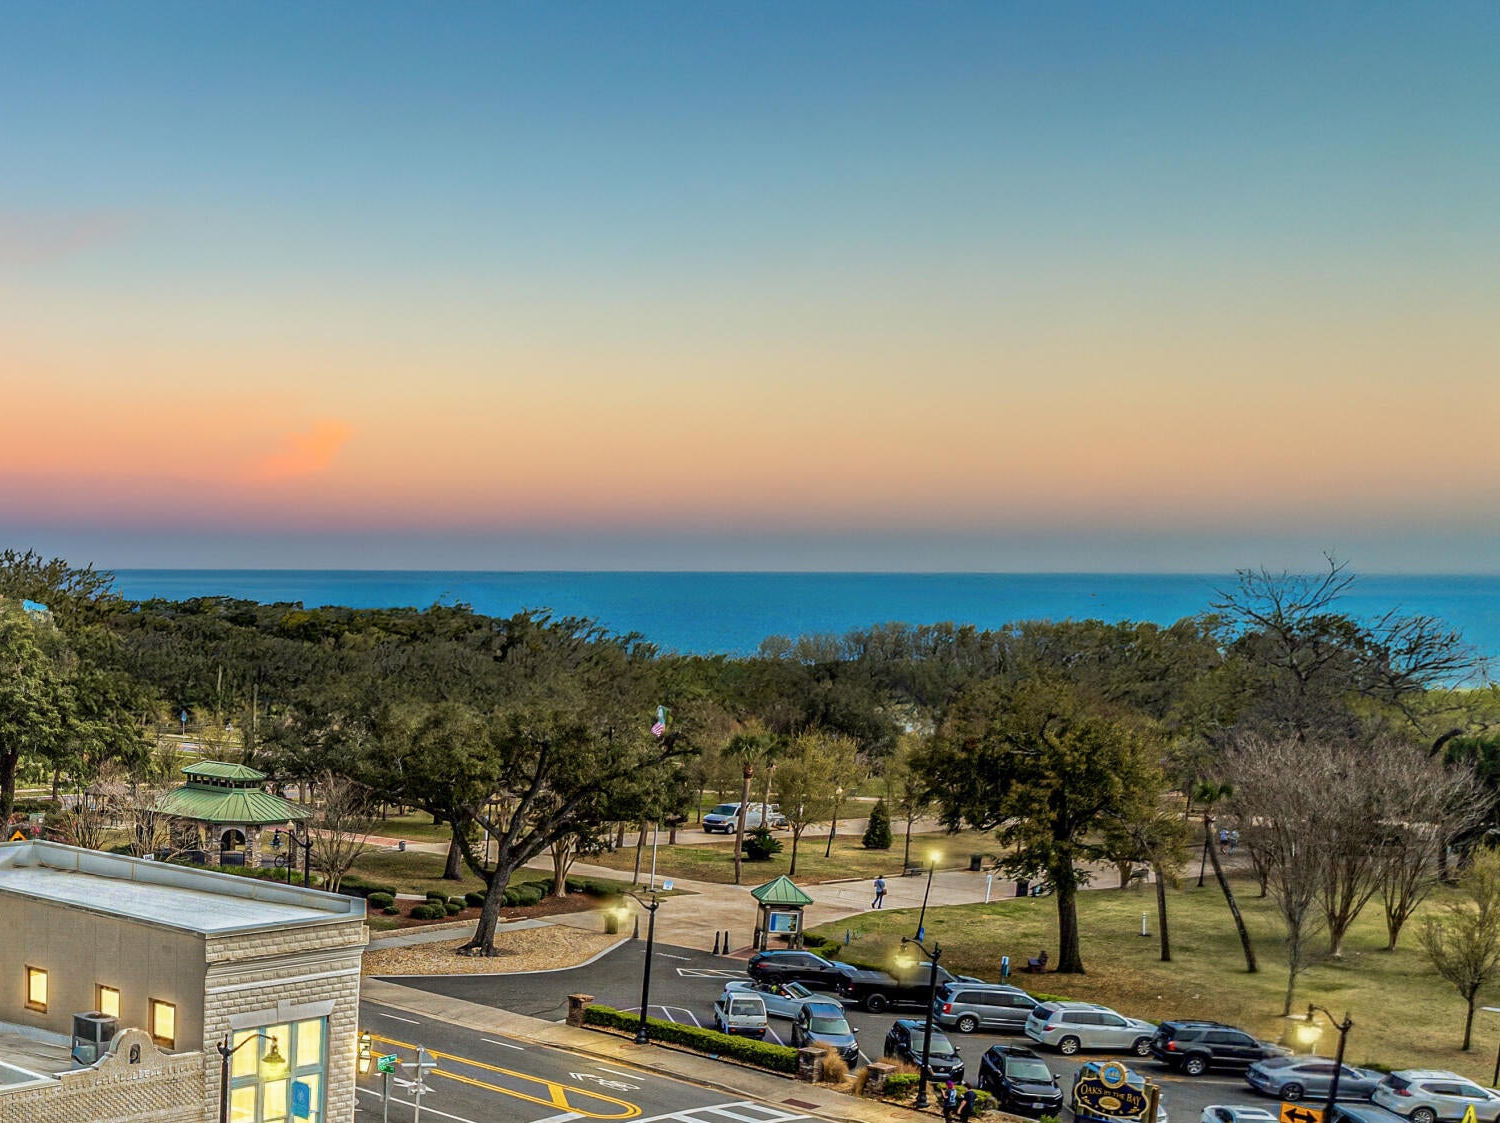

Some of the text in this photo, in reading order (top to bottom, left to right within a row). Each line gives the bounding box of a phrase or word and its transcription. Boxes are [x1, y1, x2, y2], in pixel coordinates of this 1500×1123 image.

[1080, 1083, 1103, 1095] OAKS
[1112, 1091, 1126, 1099] THE
[1126, 1093, 1142, 1106] BAY
